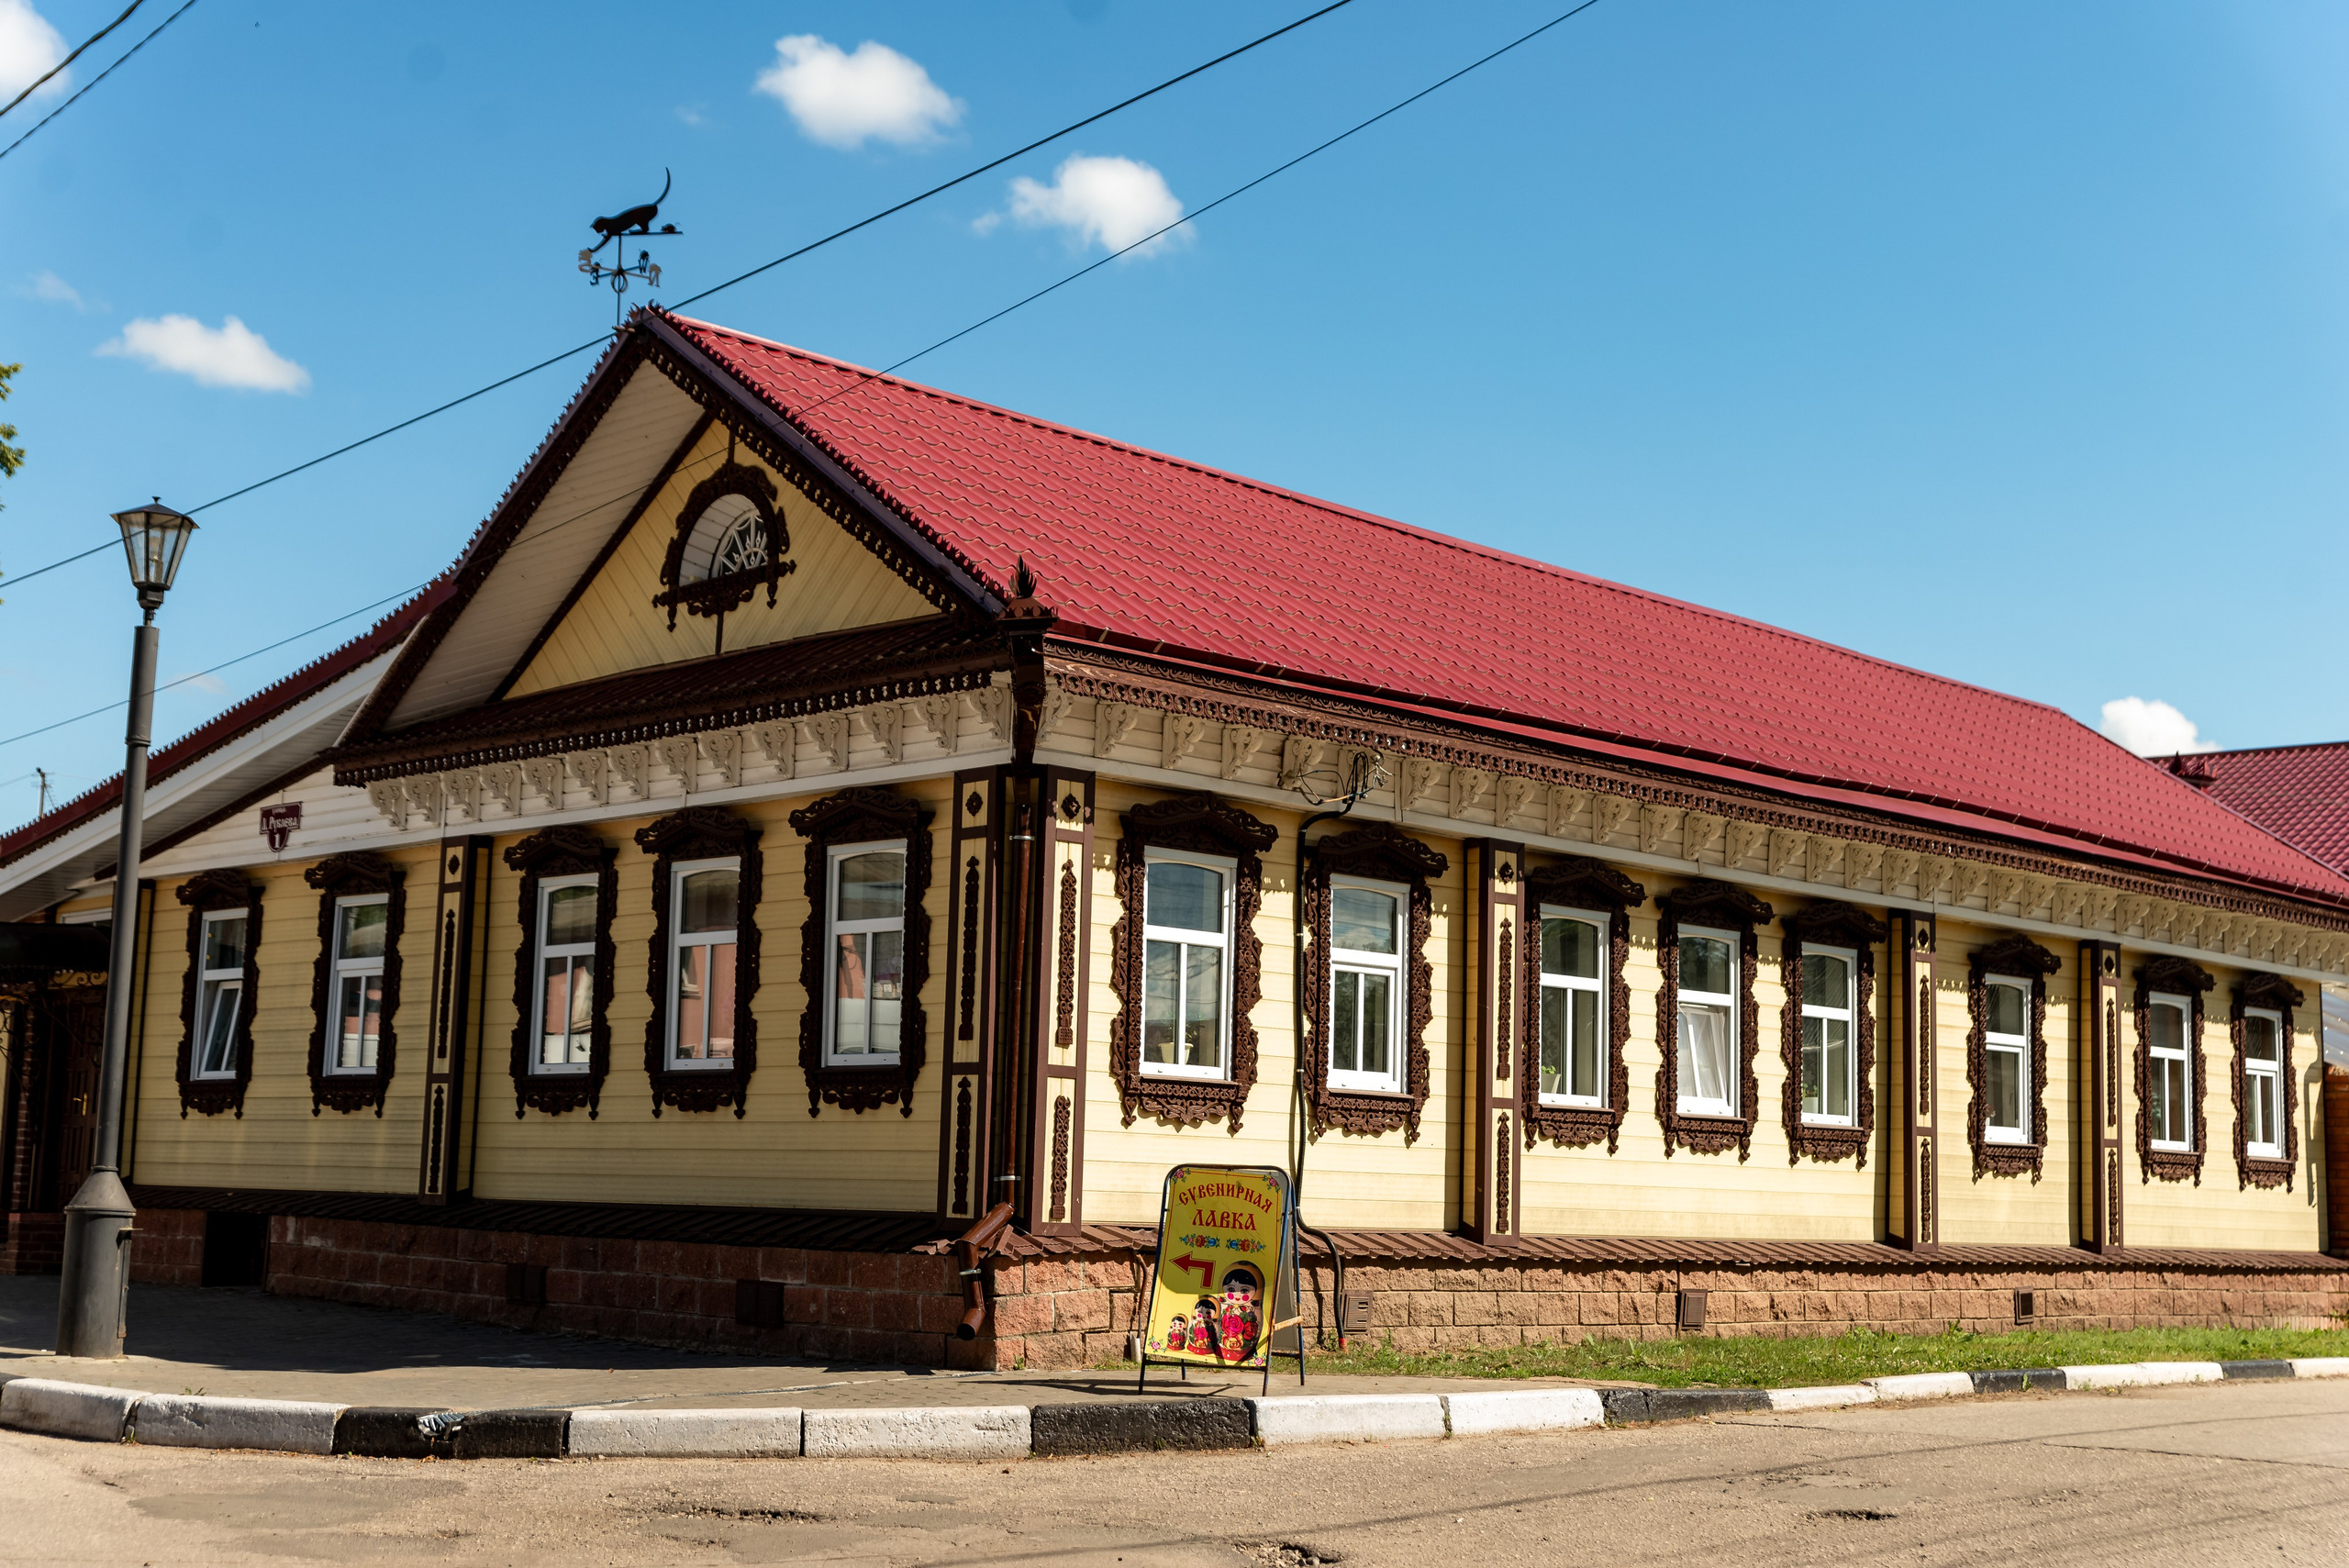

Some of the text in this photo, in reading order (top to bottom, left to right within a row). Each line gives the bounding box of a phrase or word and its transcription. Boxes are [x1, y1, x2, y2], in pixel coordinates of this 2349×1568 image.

[274, 833, 280, 849] 1
[1179, 1183, 1273, 1214] СУВЕНИРНАЯ
[1192, 1209, 1256, 1230] ЛАВКА
